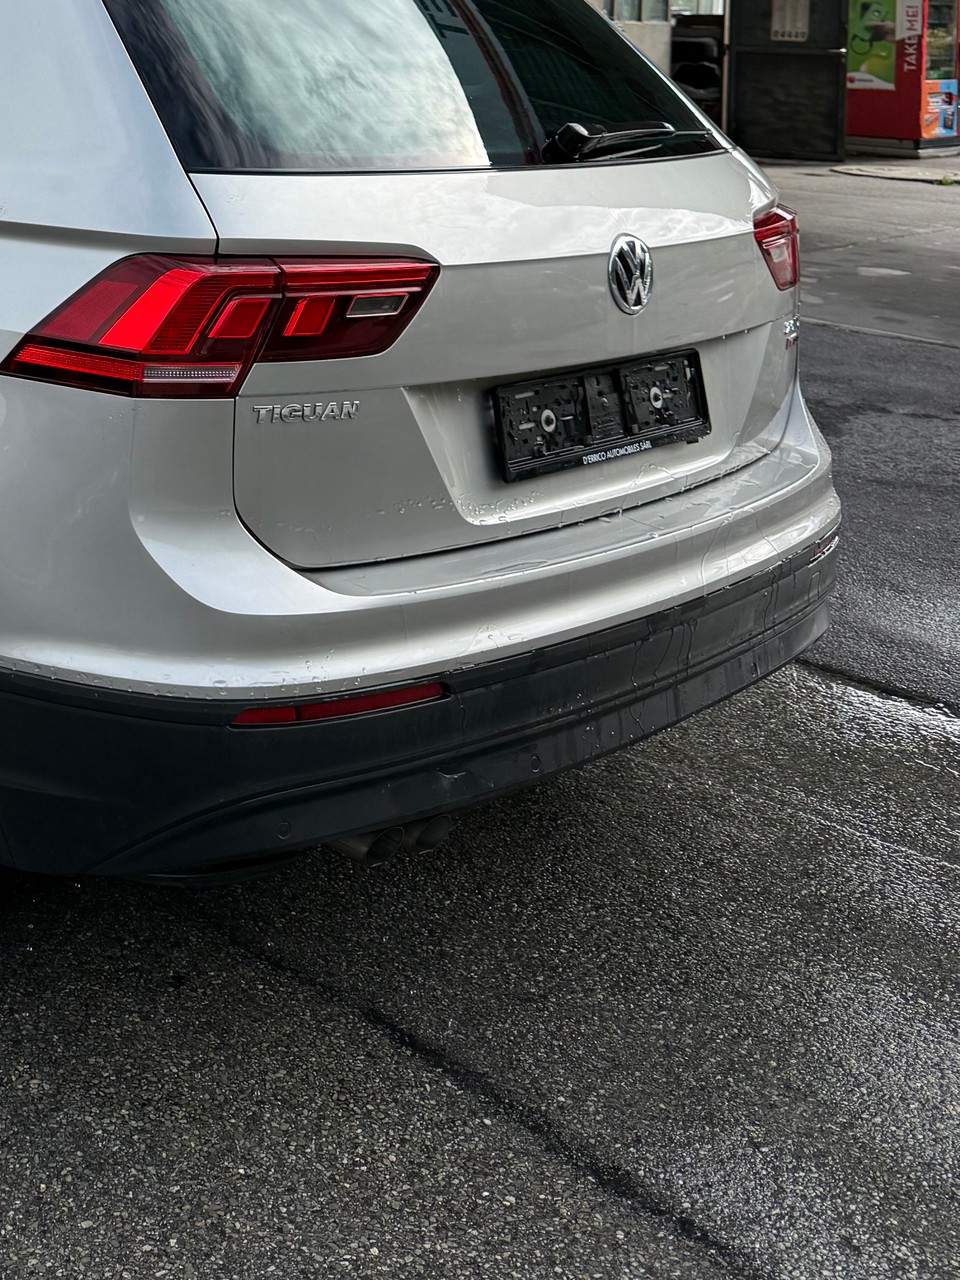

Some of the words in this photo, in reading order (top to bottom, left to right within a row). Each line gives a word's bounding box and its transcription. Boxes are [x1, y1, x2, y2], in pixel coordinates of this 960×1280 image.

[903, 35, 919, 72] TAKE
[253, 401, 360, 424] TIGUAN
[582, 451, 607, 465] D'ERRICO
[606, 443, 640, 459] AUTOMOBILES
